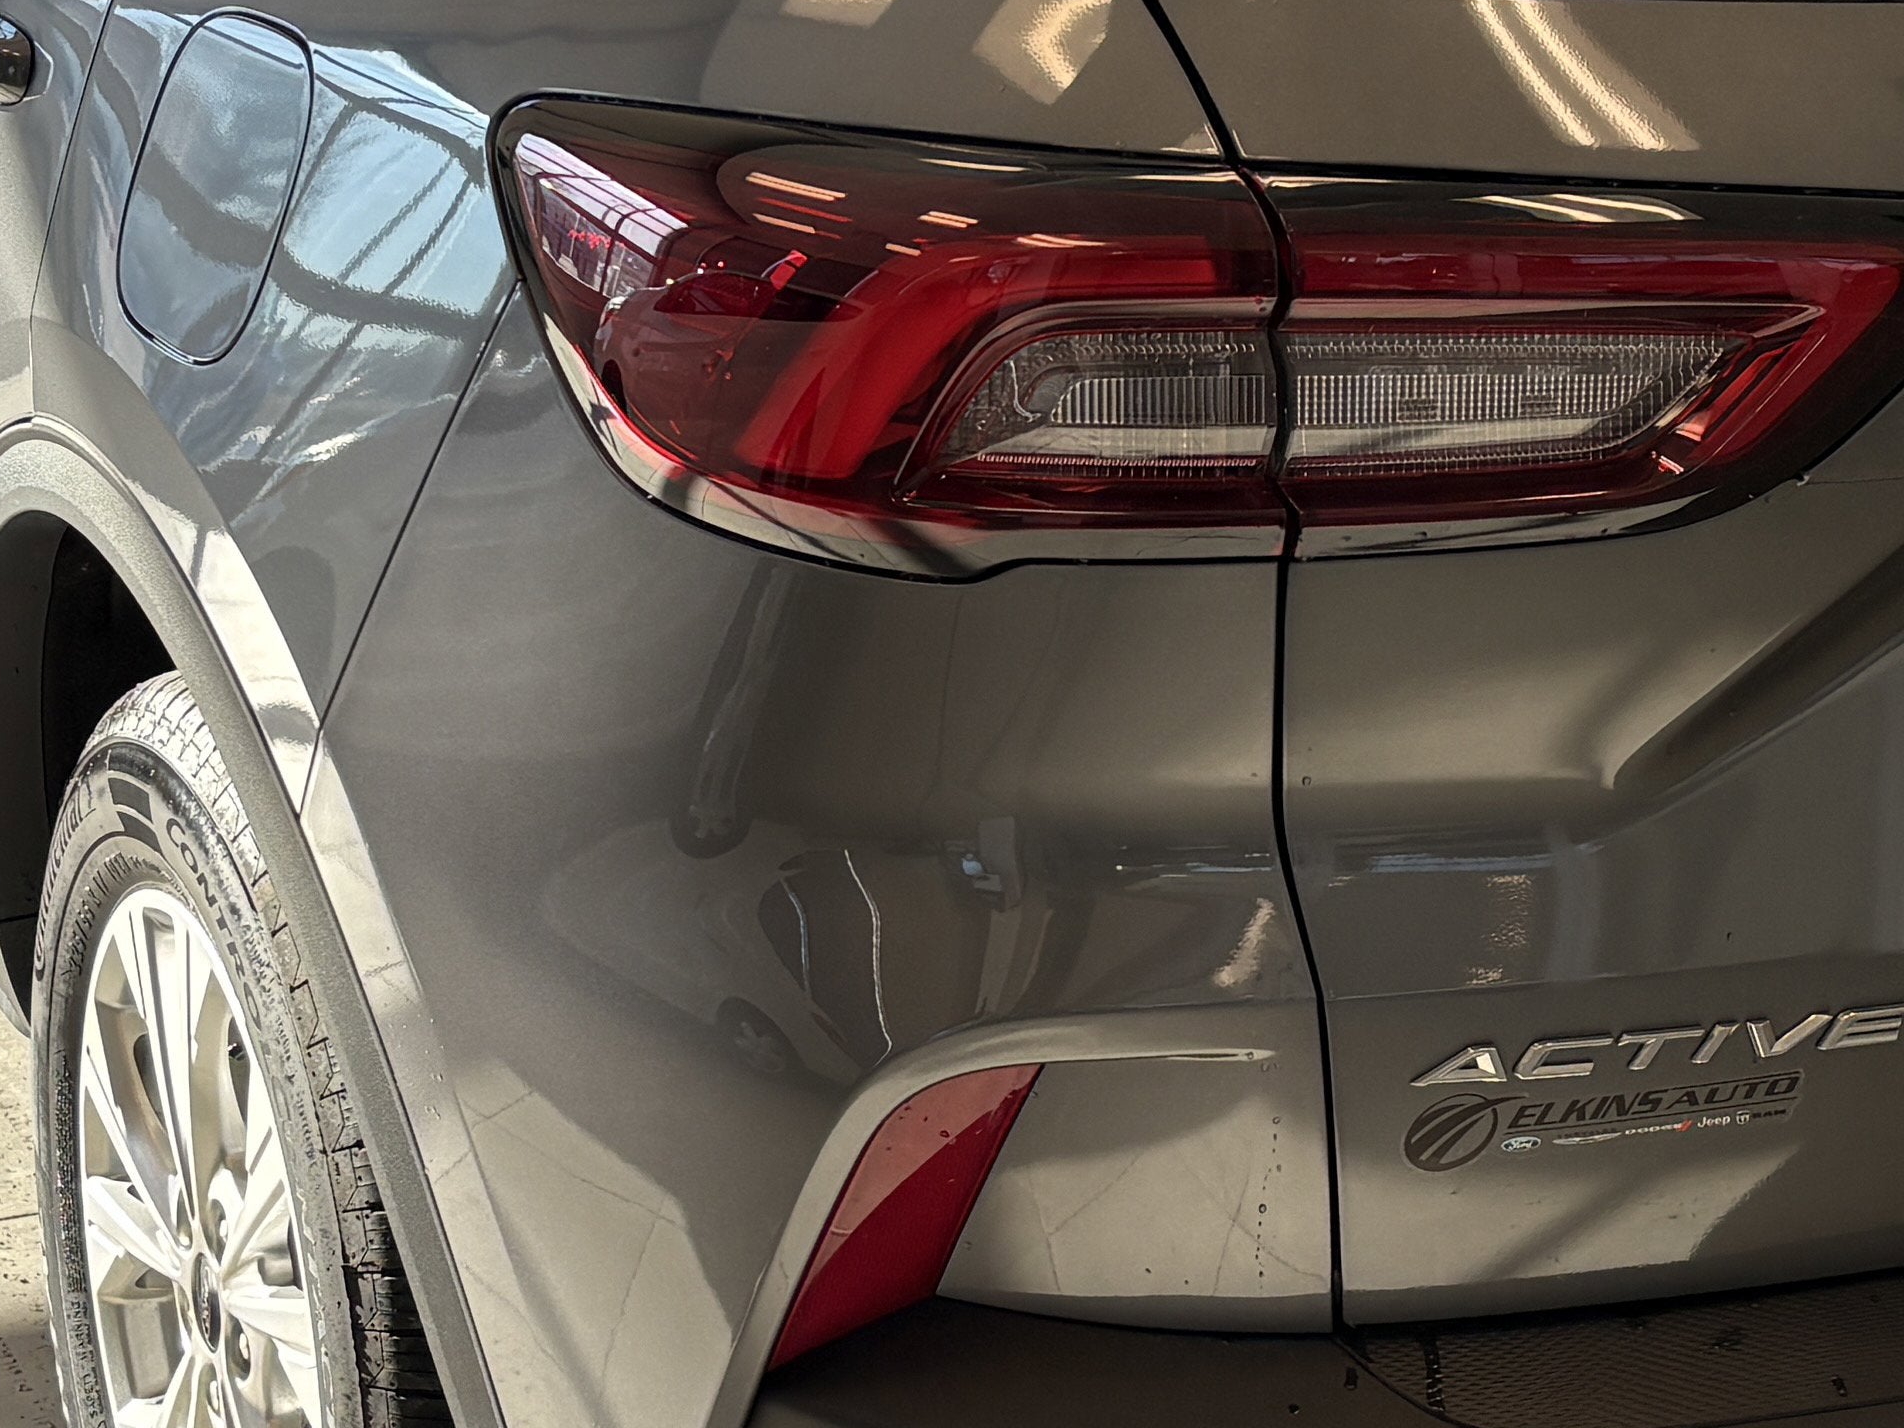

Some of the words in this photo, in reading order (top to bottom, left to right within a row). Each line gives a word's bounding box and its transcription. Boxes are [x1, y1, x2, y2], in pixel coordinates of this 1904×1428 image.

[1507, 1090, 1669, 1130] ELKINS
[1665, 1076, 1802, 1110] AUTO
[1697, 1114, 1732, 1129] Jeep
